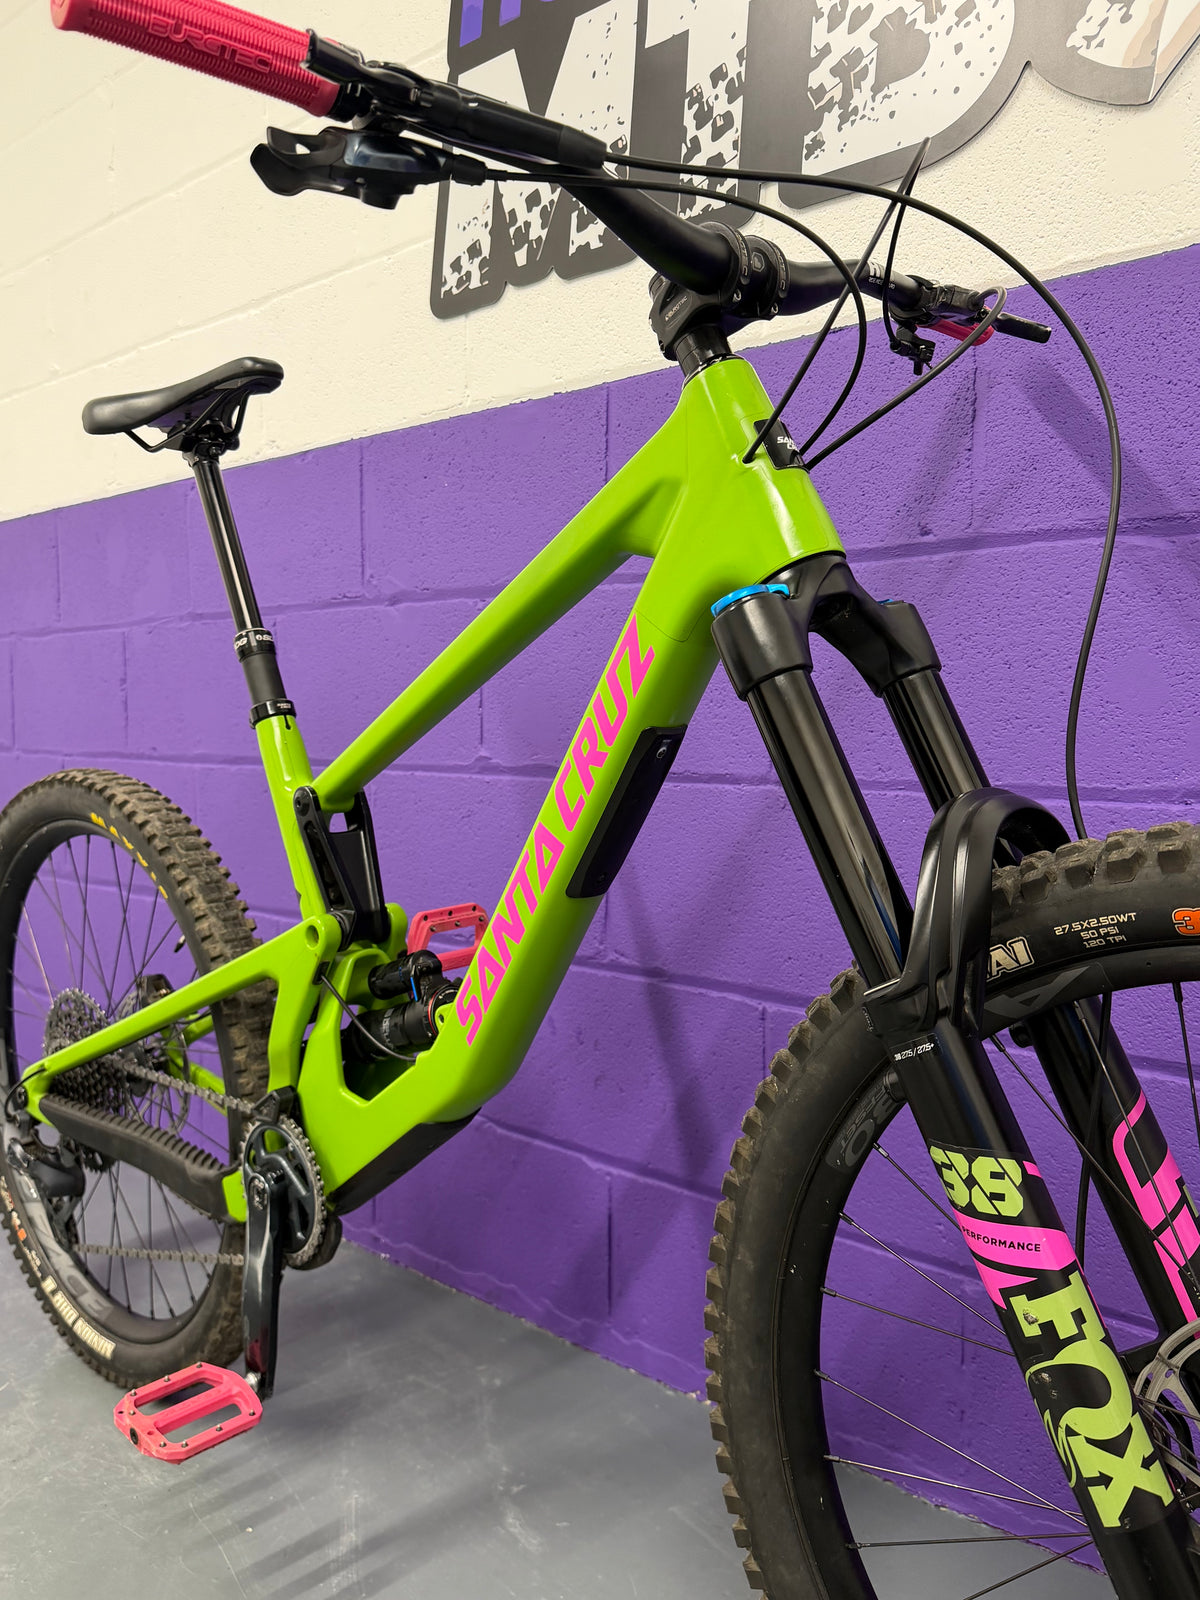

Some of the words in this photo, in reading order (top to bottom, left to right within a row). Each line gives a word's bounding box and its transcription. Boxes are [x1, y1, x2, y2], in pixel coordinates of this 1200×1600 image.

[149, 14, 273, 73] BURGTEC
[456, 826, 565, 1047] SANTA
[555, 612, 656, 832] CRUZ
[1053, 912, 1137, 936] 27.5X2.50WT
[1080, 930, 1098, 940] 50
[1099, 926, 1120, 936] PSI
[1083, 938, 1105, 948] 120
[1106, 935, 1127, 944] TPI
[986, 936, 1035, 982] AI
[930, 1145, 1024, 1218] 38
[962, 1225, 1041, 1253] PERFORMANCE
[1009, 1270, 1175, 1528] FOX
